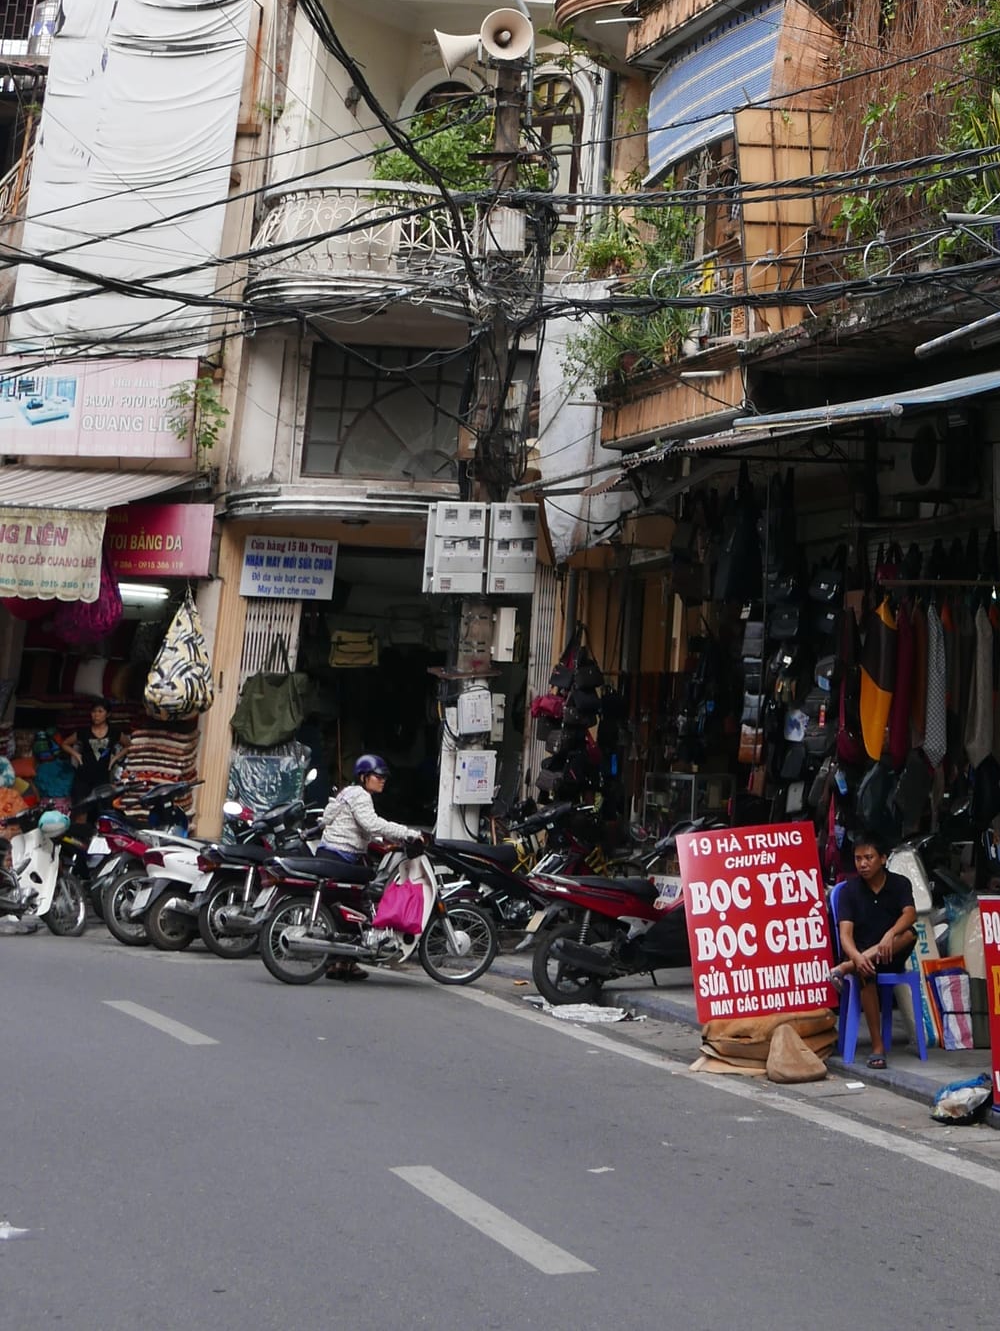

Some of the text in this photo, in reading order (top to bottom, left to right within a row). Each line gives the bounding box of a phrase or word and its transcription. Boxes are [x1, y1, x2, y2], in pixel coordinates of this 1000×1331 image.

[82, 414, 144, 433] QUANG
[25, 521, 69, 547] LIÊN
[165, 534, 183, 550] DA
[287, 541, 298, 553] 15
[310, 542, 334, 556] Trung
[286, 586, 301, 597] che
[688, 830, 803, 857] 19 HÀ TRUNG
[724, 851, 777, 869] CHUYÊN
[688, 862, 821, 922] BỌC YÊN
[695, 899, 828, 969] BỌC GHẾ
[698, 955, 831, 998] SỬA TÚI THAY KHÓA
[710, 985, 828, 1017] MAY CÁC LOẠI VẢI BẠT
